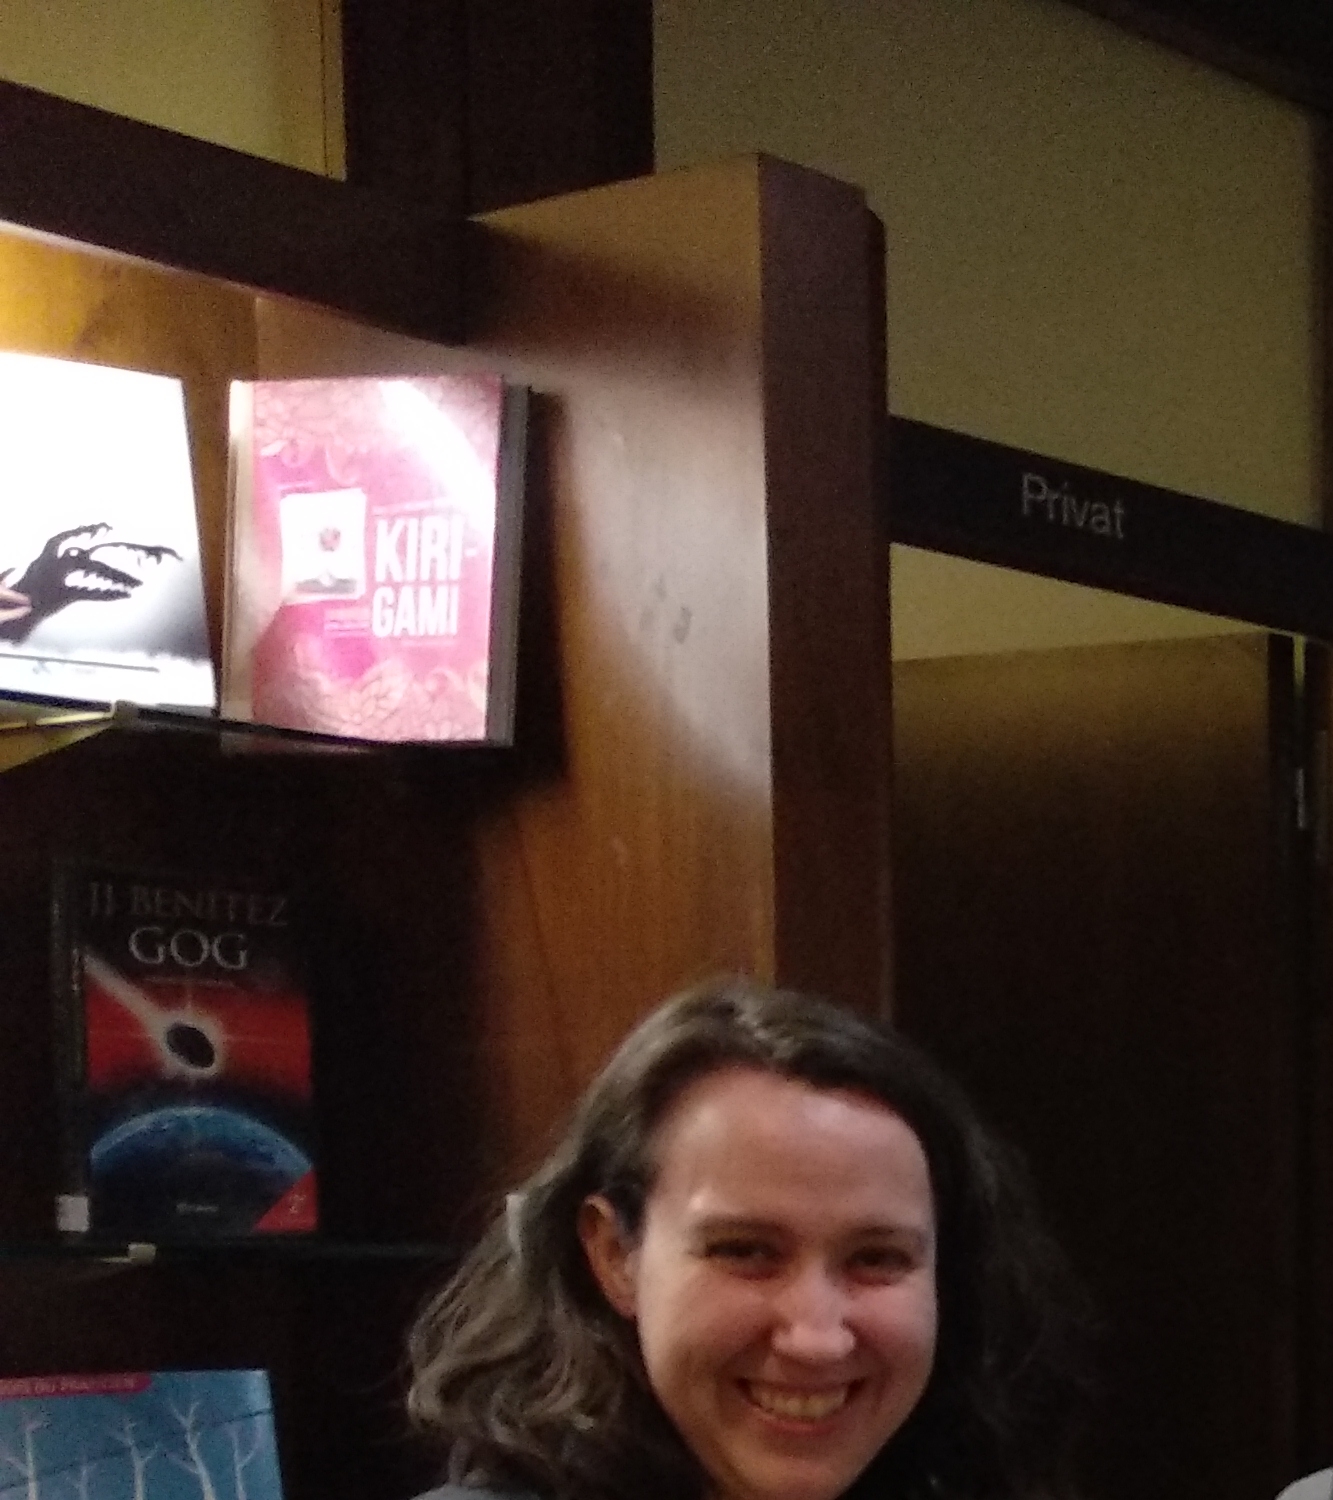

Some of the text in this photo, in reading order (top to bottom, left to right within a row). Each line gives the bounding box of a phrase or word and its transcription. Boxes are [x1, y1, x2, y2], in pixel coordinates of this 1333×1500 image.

[1020, 471, 1125, 540] Privat
[372, 585, 459, 638] GAMI
[128, 926, 249, 970] GOG
